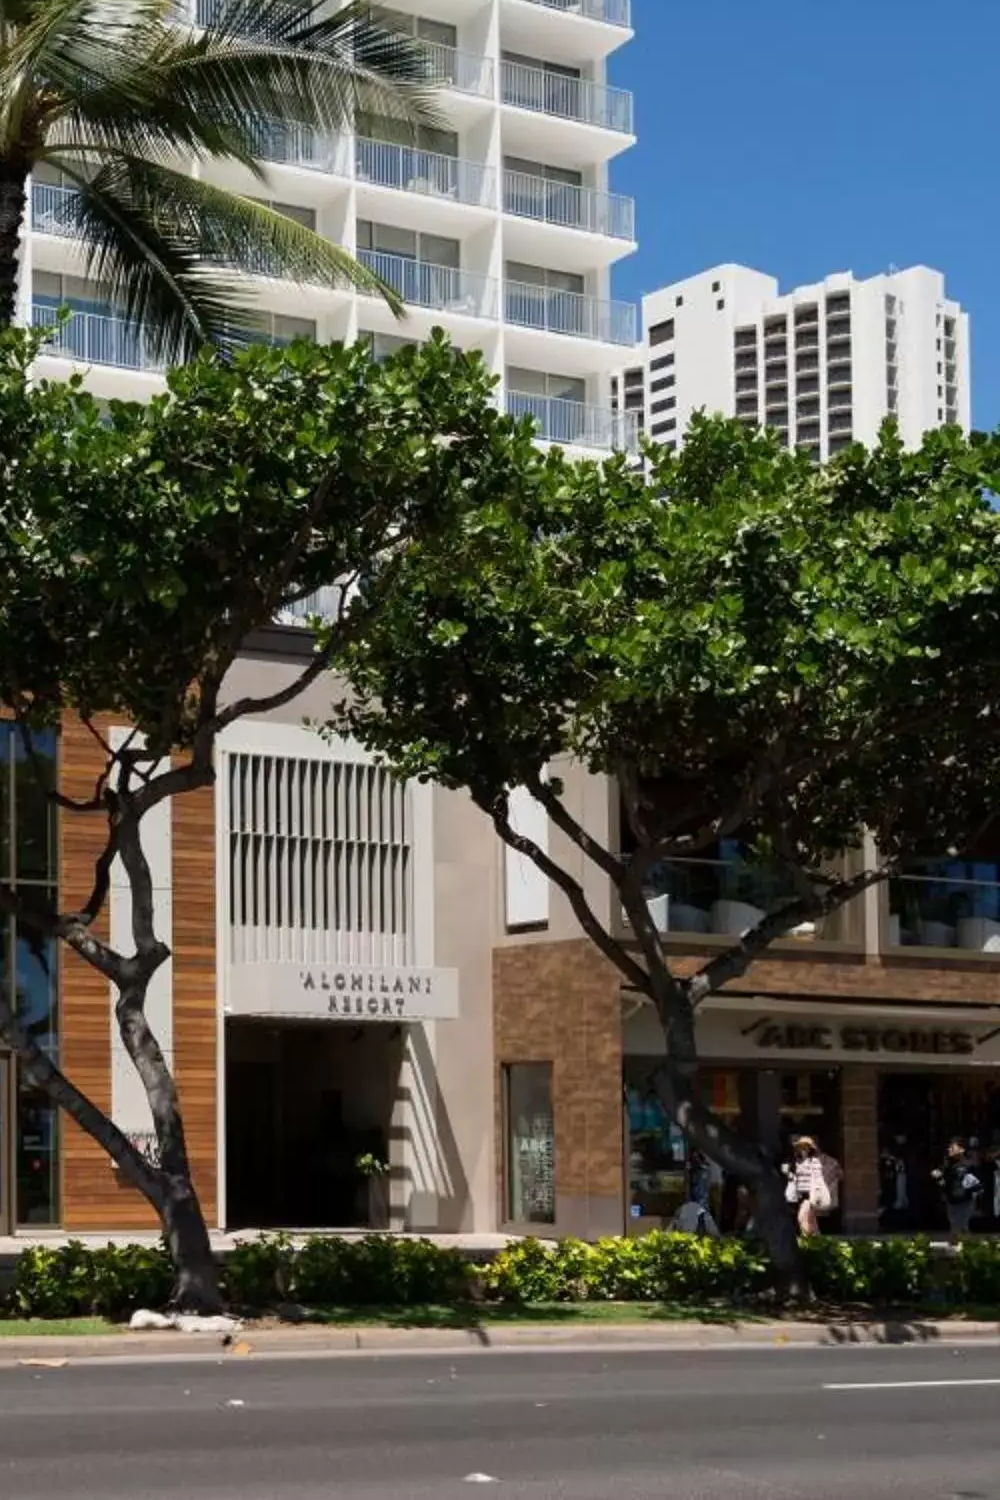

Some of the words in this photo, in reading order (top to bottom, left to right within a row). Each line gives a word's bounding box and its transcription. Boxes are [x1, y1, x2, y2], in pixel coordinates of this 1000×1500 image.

[328, 995, 404, 1014] RESORT
[756, 1024, 833, 1050] ABC
[840, 1026, 976, 1055] STORES
